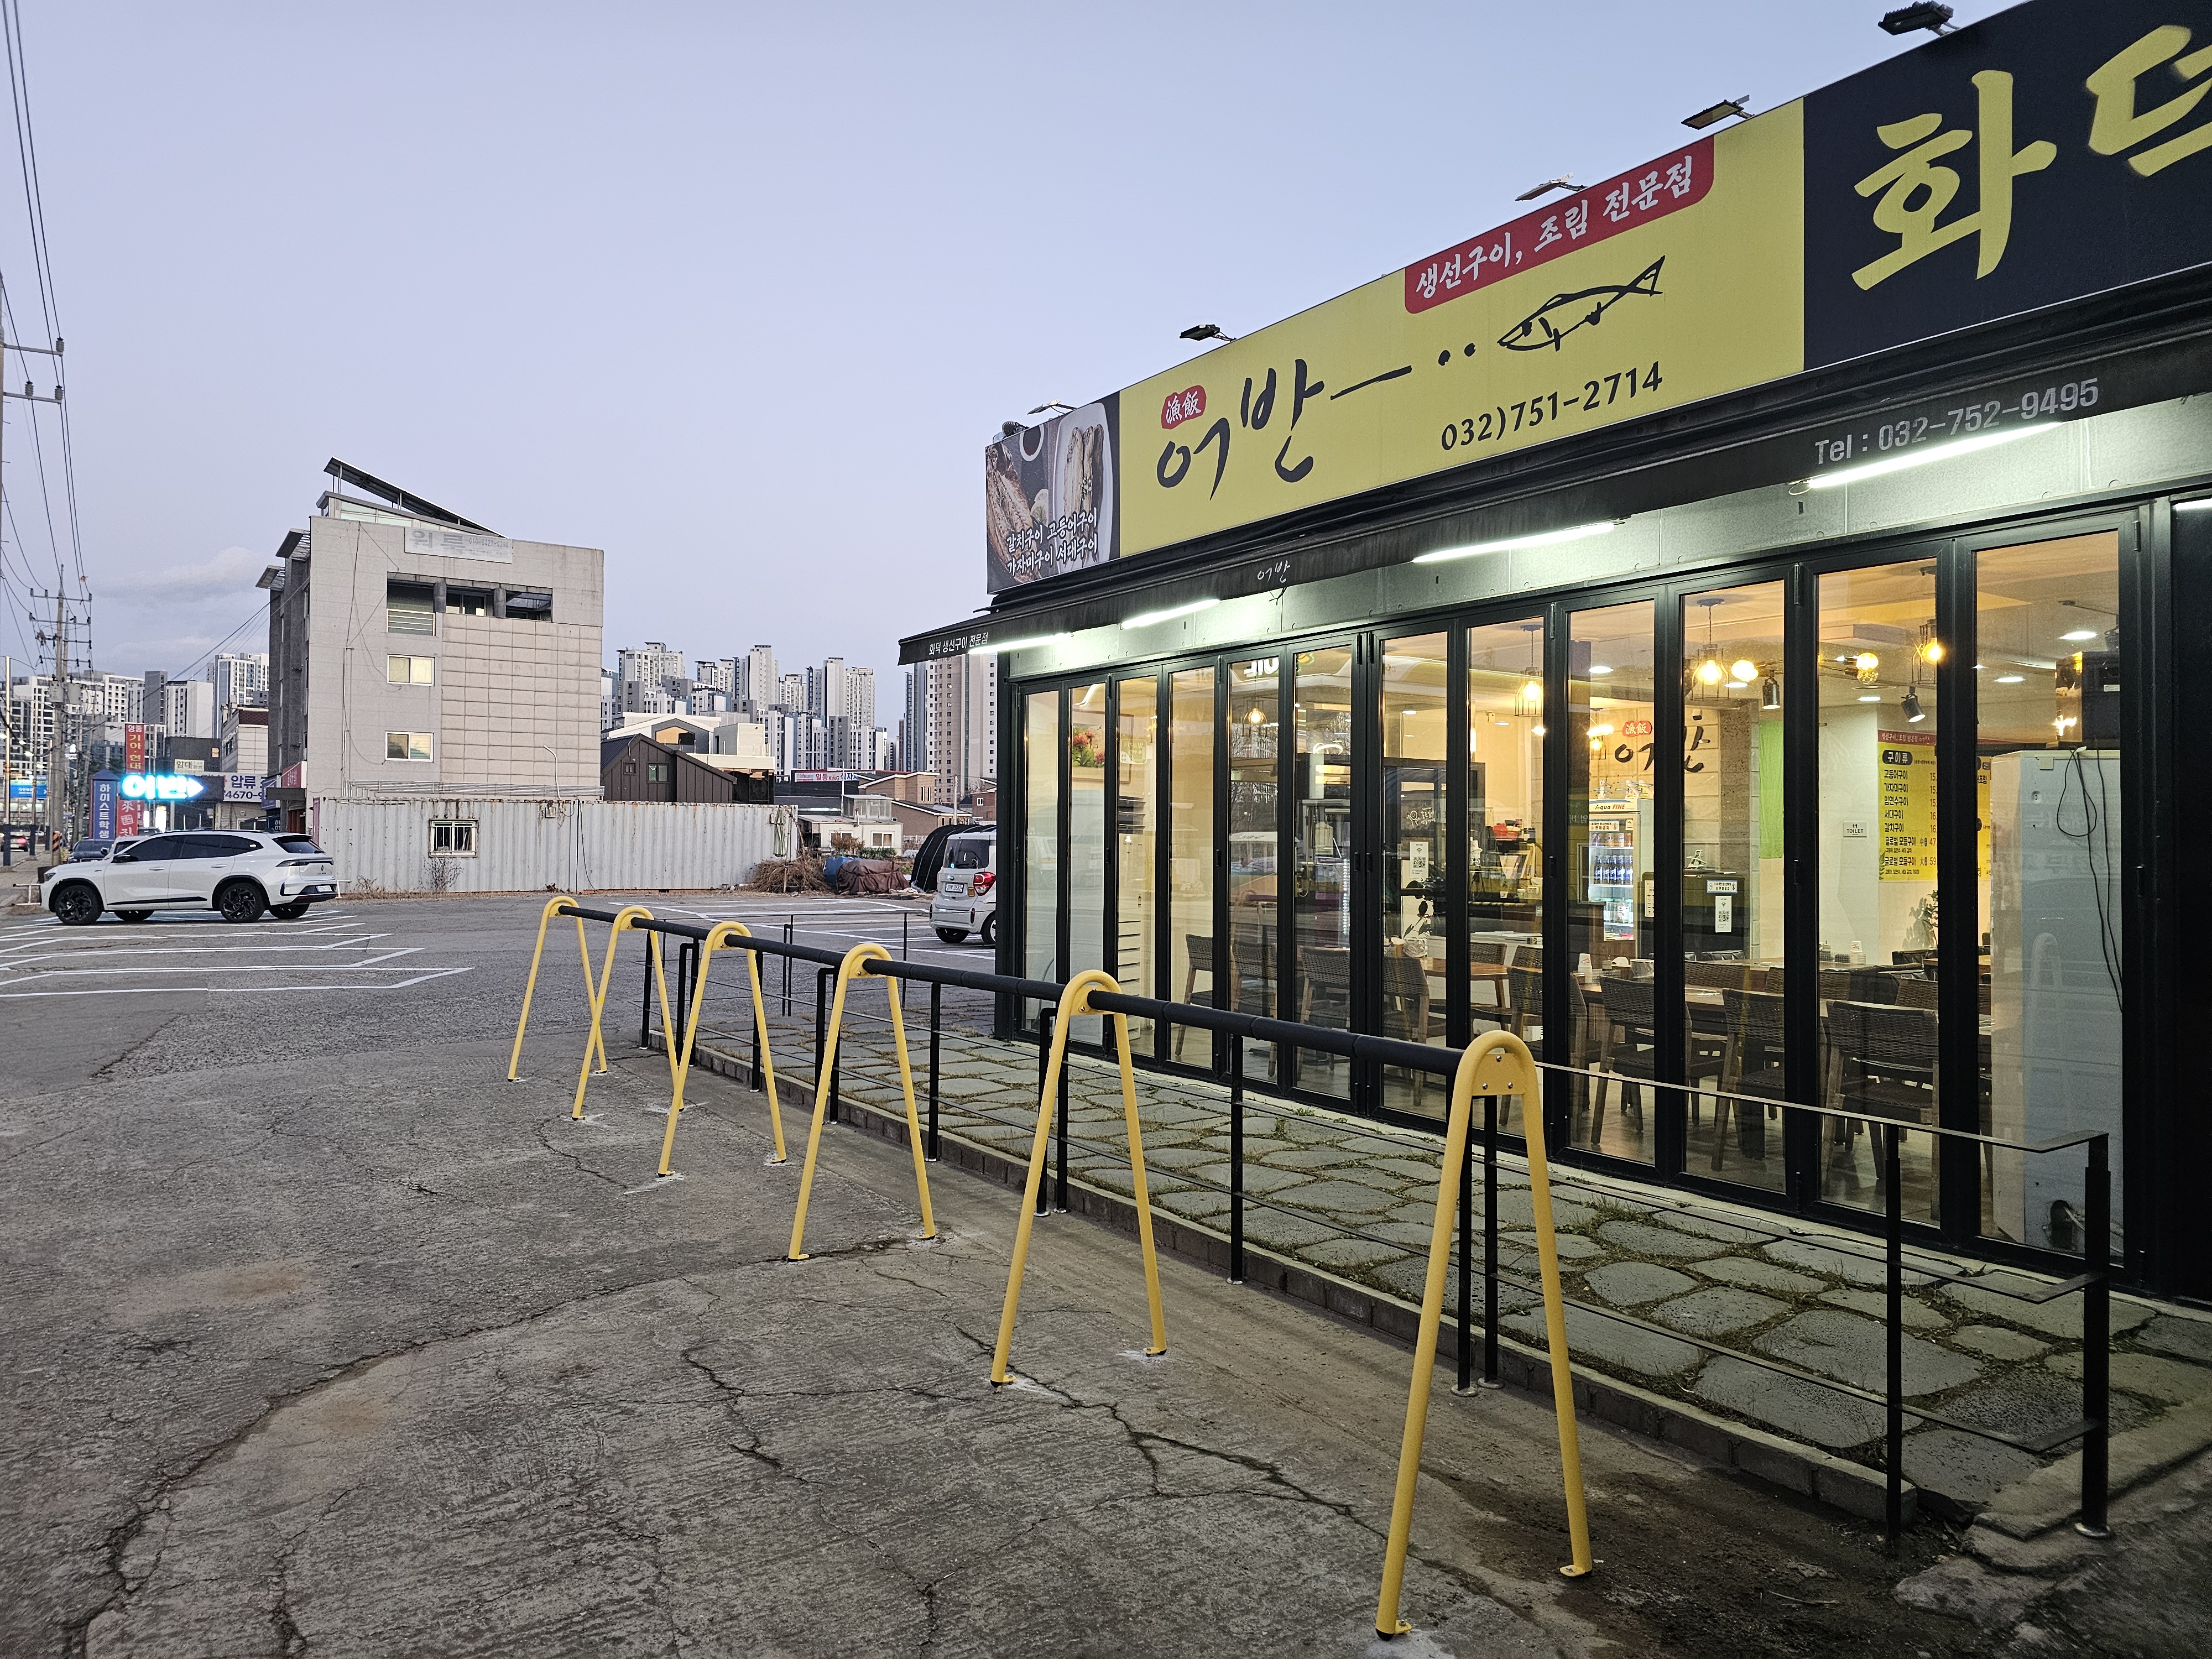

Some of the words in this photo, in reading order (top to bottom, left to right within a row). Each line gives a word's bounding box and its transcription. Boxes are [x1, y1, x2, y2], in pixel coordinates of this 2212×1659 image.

[1415, 232, 1522, 300] 생선구이,
[1533, 199, 1588, 253] 조림
[1603, 155, 1693, 222] 전문점
[1165, 390, 1202, 425] 漁飯
[1441, 361, 1663, 451] 032)751-2714
[1879, 377, 2100, 452] 032-752-9495
[1006, 524, 1043, 553] 갈치구이
[1047, 507, 1097, 540] 고등어구이
[1007, 546, 1053, 576] 가자미구이
[1056, 533, 1097, 563] 서대구이
[929, 641, 941, 656] 화덕
[942, 636, 968, 653] 생선구이
[969, 632, 989, 648] 전문점
[128, 724, 142, 733] 영종
[1887, 752, 1908, 764] 구이류
[1884, 769, 1908, 780] 고등어구이
[231, 775, 256, 789] 압류
[1884, 782, 1908, 793] 가자미구이
[1884, 796, 1908, 806] 임연수구이
[1885, 810, 1903, 820] 서대구이
[1885, 822, 1904, 832] 갈치구이
[1885, 837, 1898, 846] 글로벌
